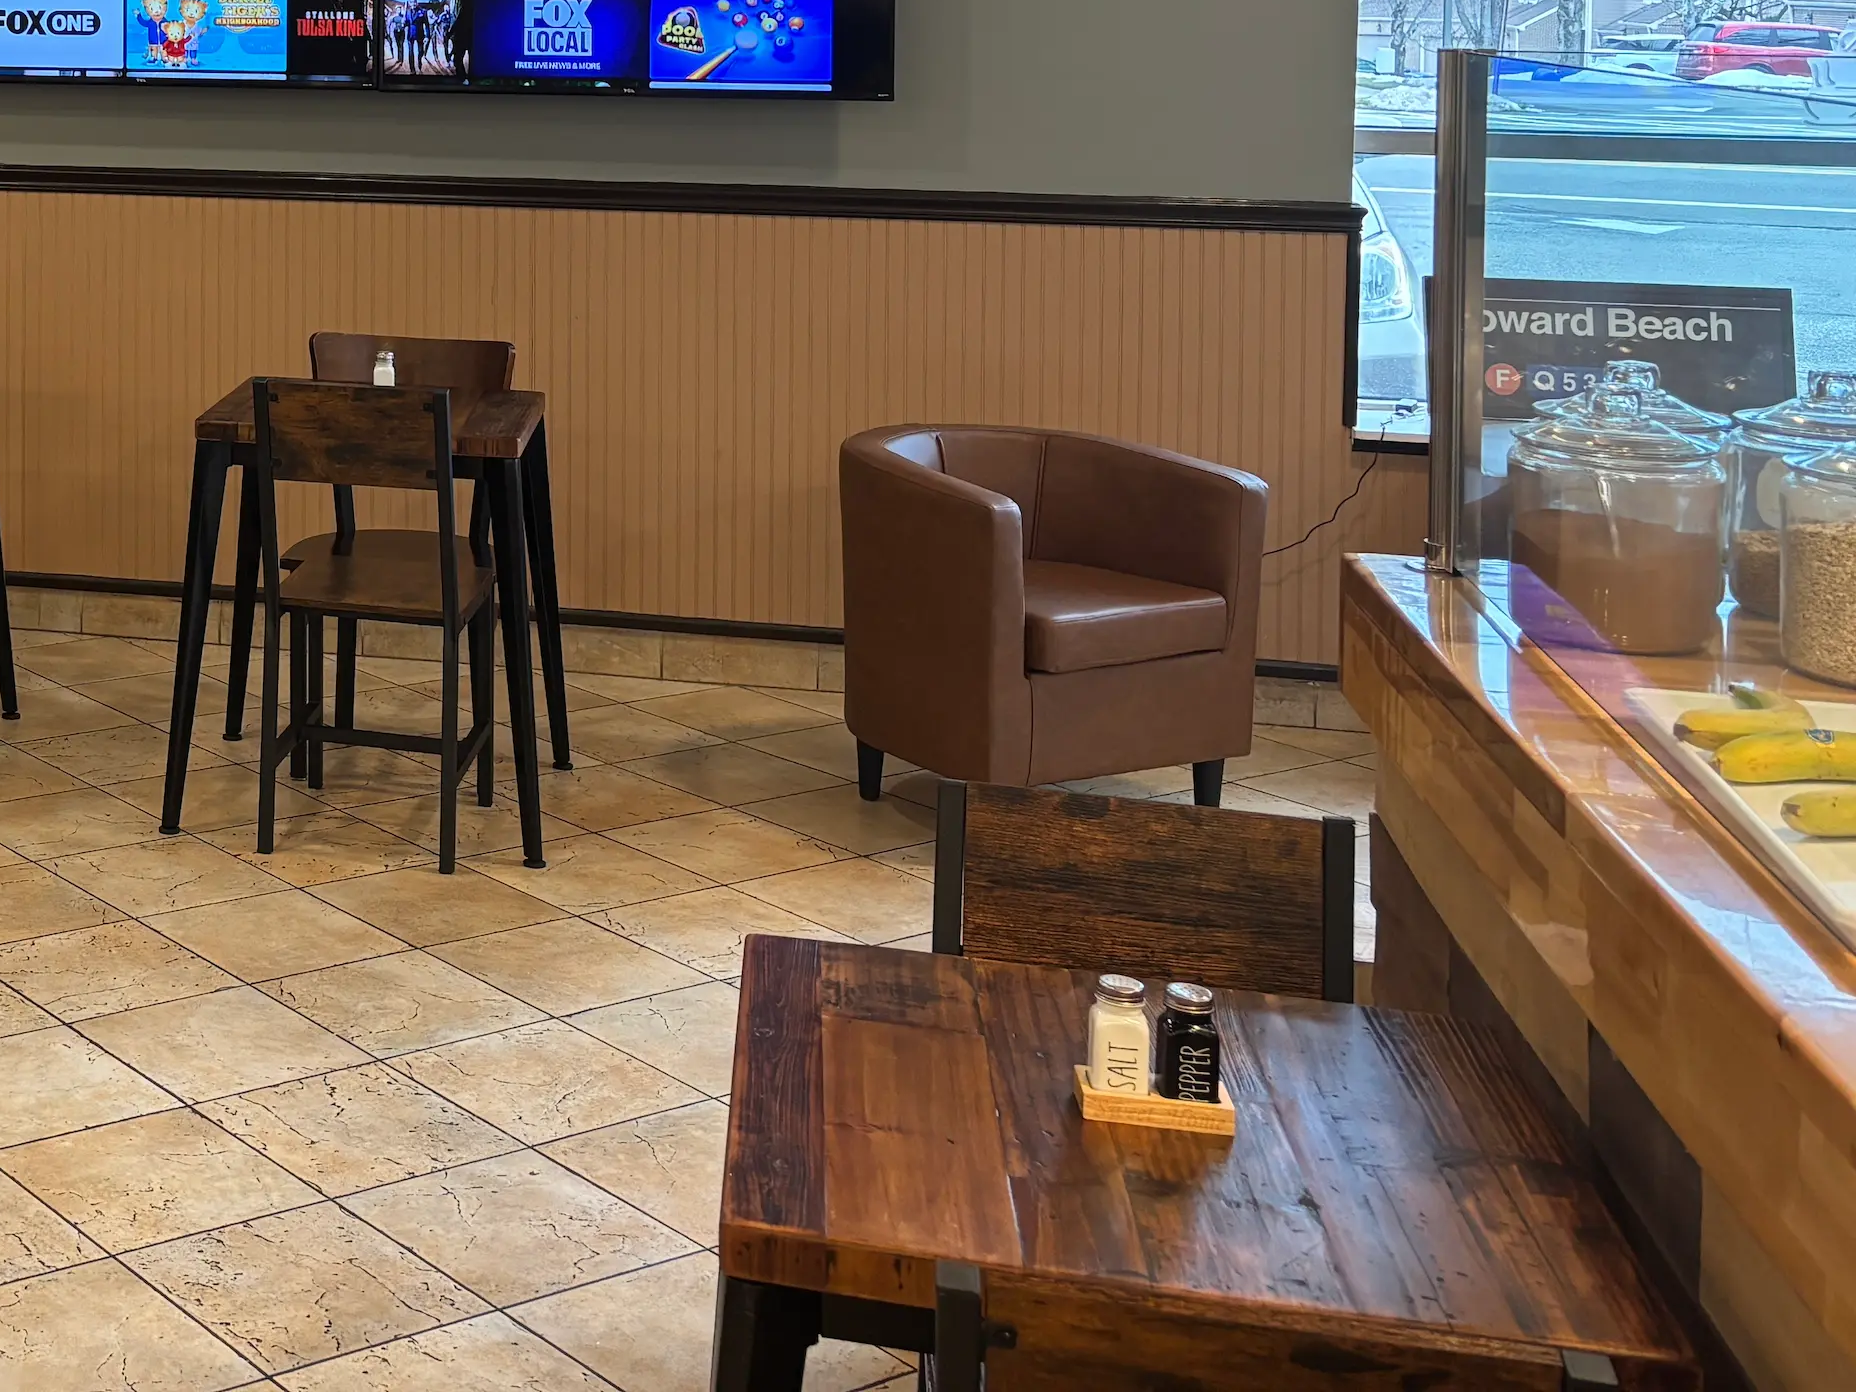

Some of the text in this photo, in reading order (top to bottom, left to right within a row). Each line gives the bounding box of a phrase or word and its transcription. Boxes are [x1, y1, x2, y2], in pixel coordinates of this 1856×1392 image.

[52, 14, 95, 32] ONE
[296, 18, 365, 37] TULSA KING
[527, 30, 589, 53] LOCAL
[666, 35, 698, 44] PARTY
[1483, 306, 1733, 342] oward Beach
[1107, 1041, 1139, 1091] SALT
[1178, 1045, 1211, 1103] PEPPER
